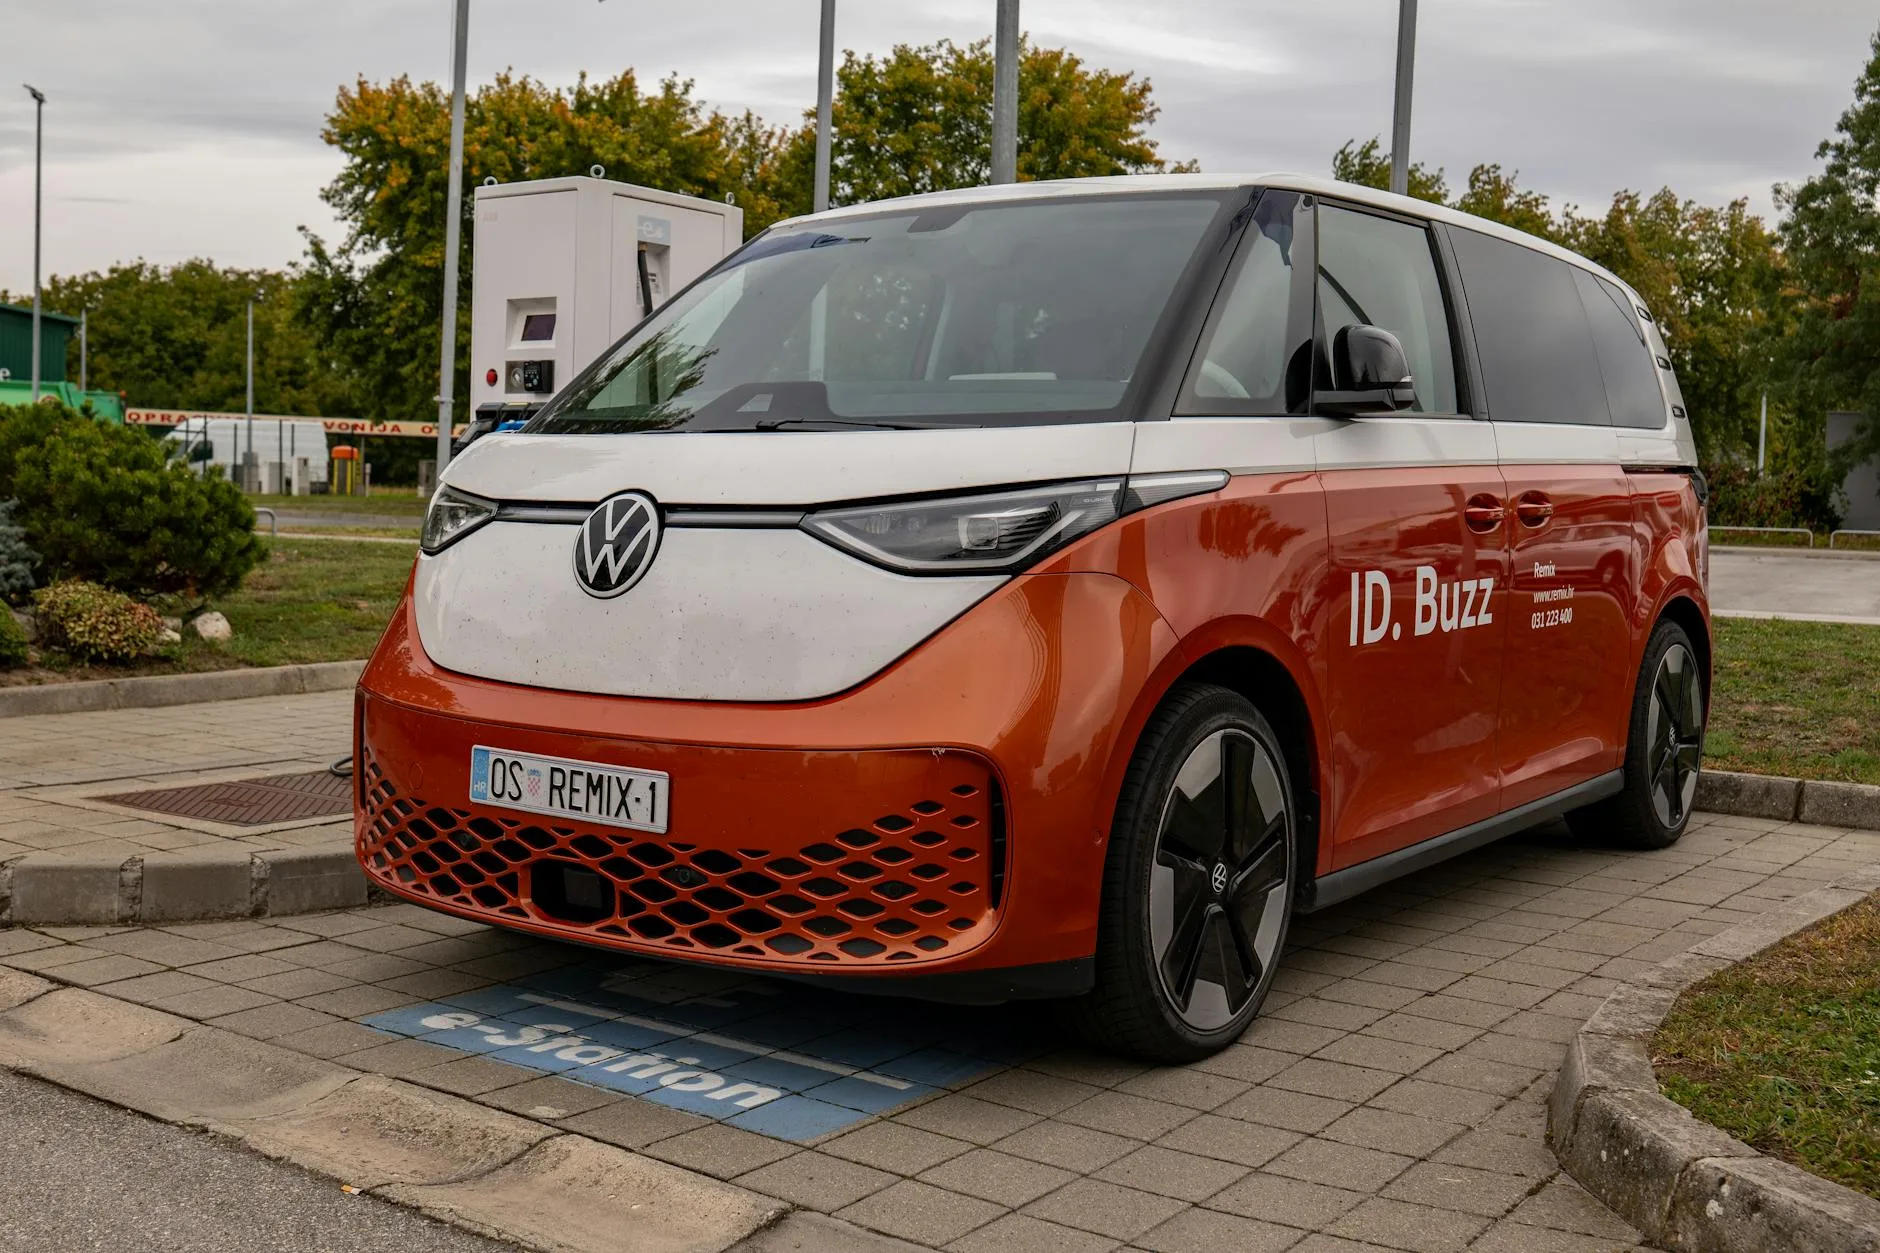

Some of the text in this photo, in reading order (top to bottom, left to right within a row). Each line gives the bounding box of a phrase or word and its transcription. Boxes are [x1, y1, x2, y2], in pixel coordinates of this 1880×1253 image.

[322, 421, 402, 433] VONIJA
[1534, 560, 1556, 578] Remix
[1533, 584, 1575, 604] www.remix.hr
[1349, 565, 1494, 647] ID. Buzz
[1531, 607, 1573, 630] 031 223 400
[491, 757, 523, 801] OS
[549, 766, 657, 823] REMIX-1
[420, 1012, 783, 1108] e-Station
